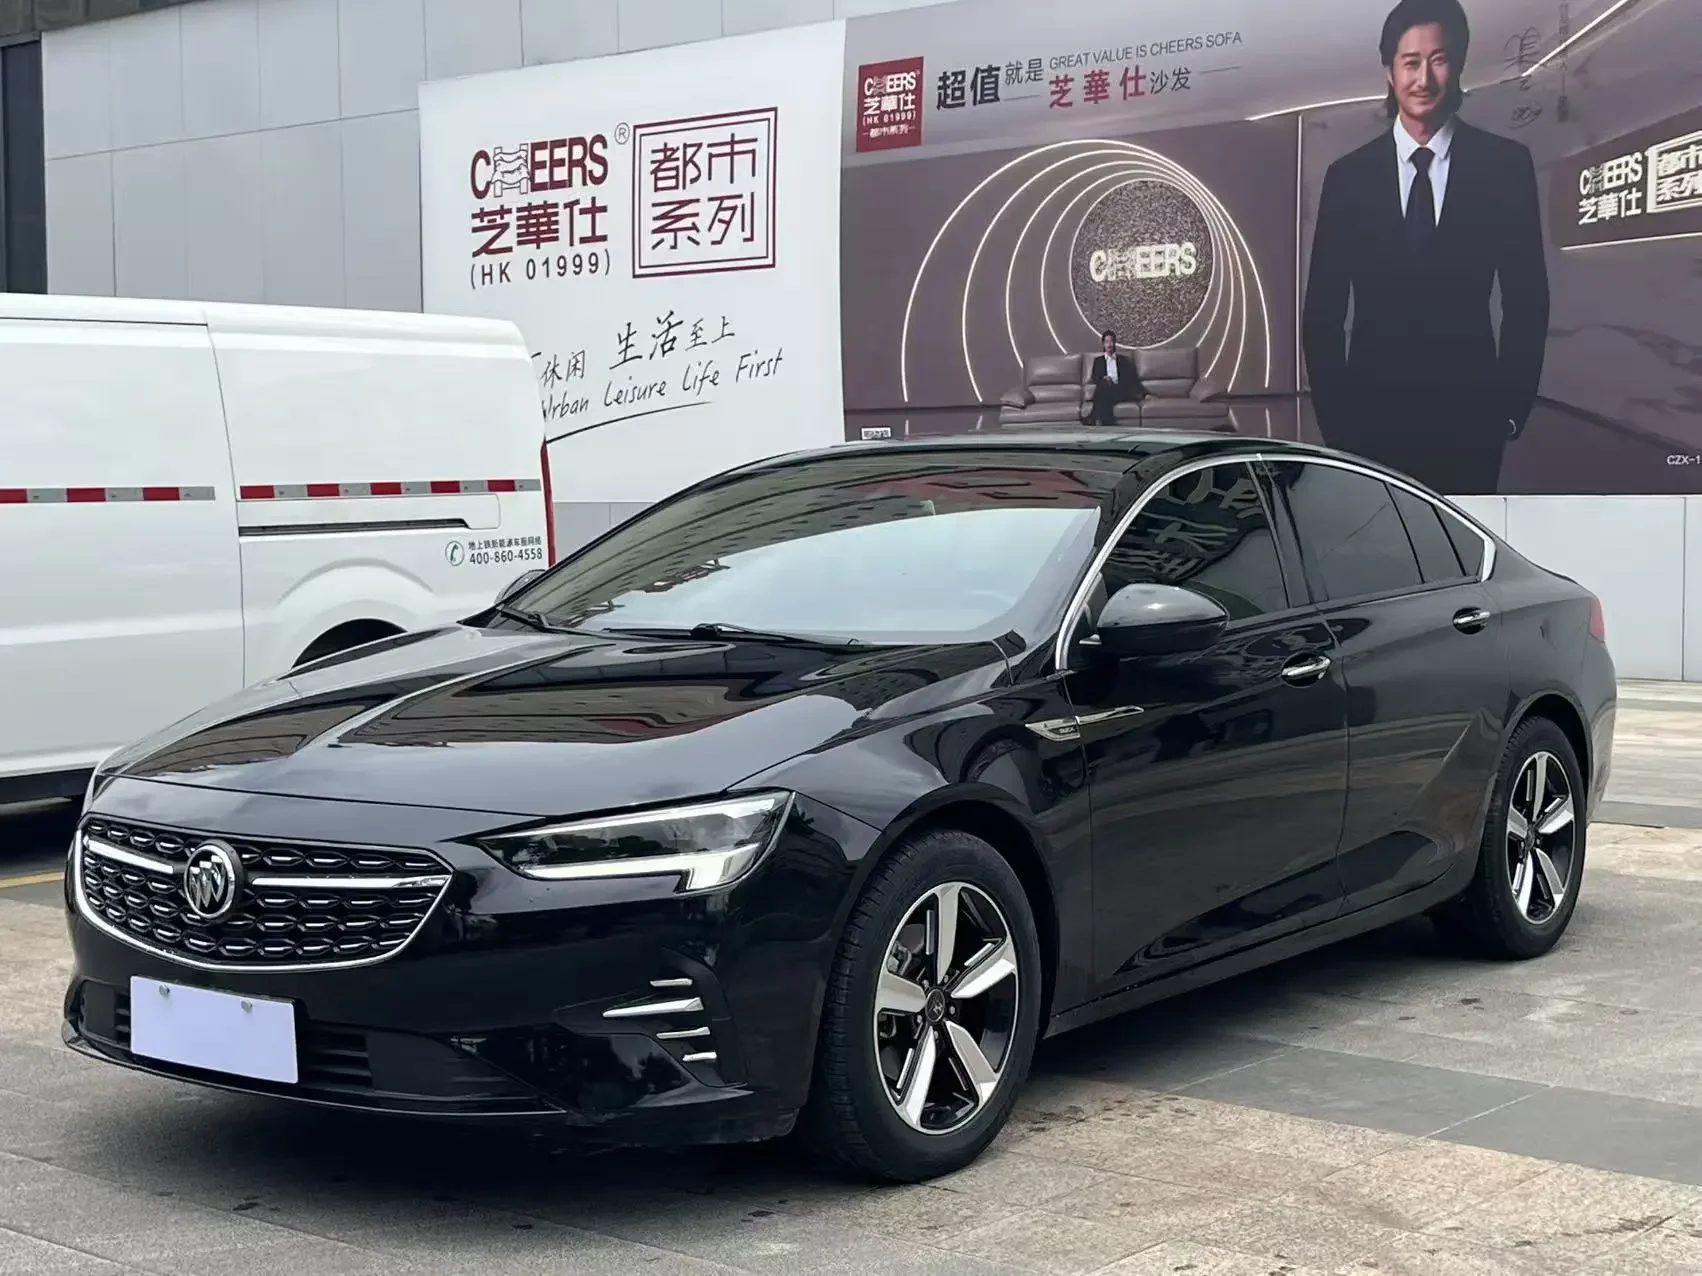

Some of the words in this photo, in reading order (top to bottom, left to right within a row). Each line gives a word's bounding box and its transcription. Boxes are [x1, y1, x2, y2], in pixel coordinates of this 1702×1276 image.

[1049, 52, 1091, 71] GREAT
[1093, 46, 1133, 65] VALUE
[1136, 45, 1148, 57] IS
[1150, 38, 1204, 57] CHEERS
[1205, 31, 1243, 49] SOFA
[650, 132, 760, 193] 都市
[650, 192, 757, 251] 系列
[470, 261, 513, 291] (HK
[525, 248, 611, 281] 01999)
[603, 375, 667, 408] Leisure
[682, 359, 721, 396] Life
[735, 347, 784, 384] First
[469, 547, 543, 565] 400-860-4558
